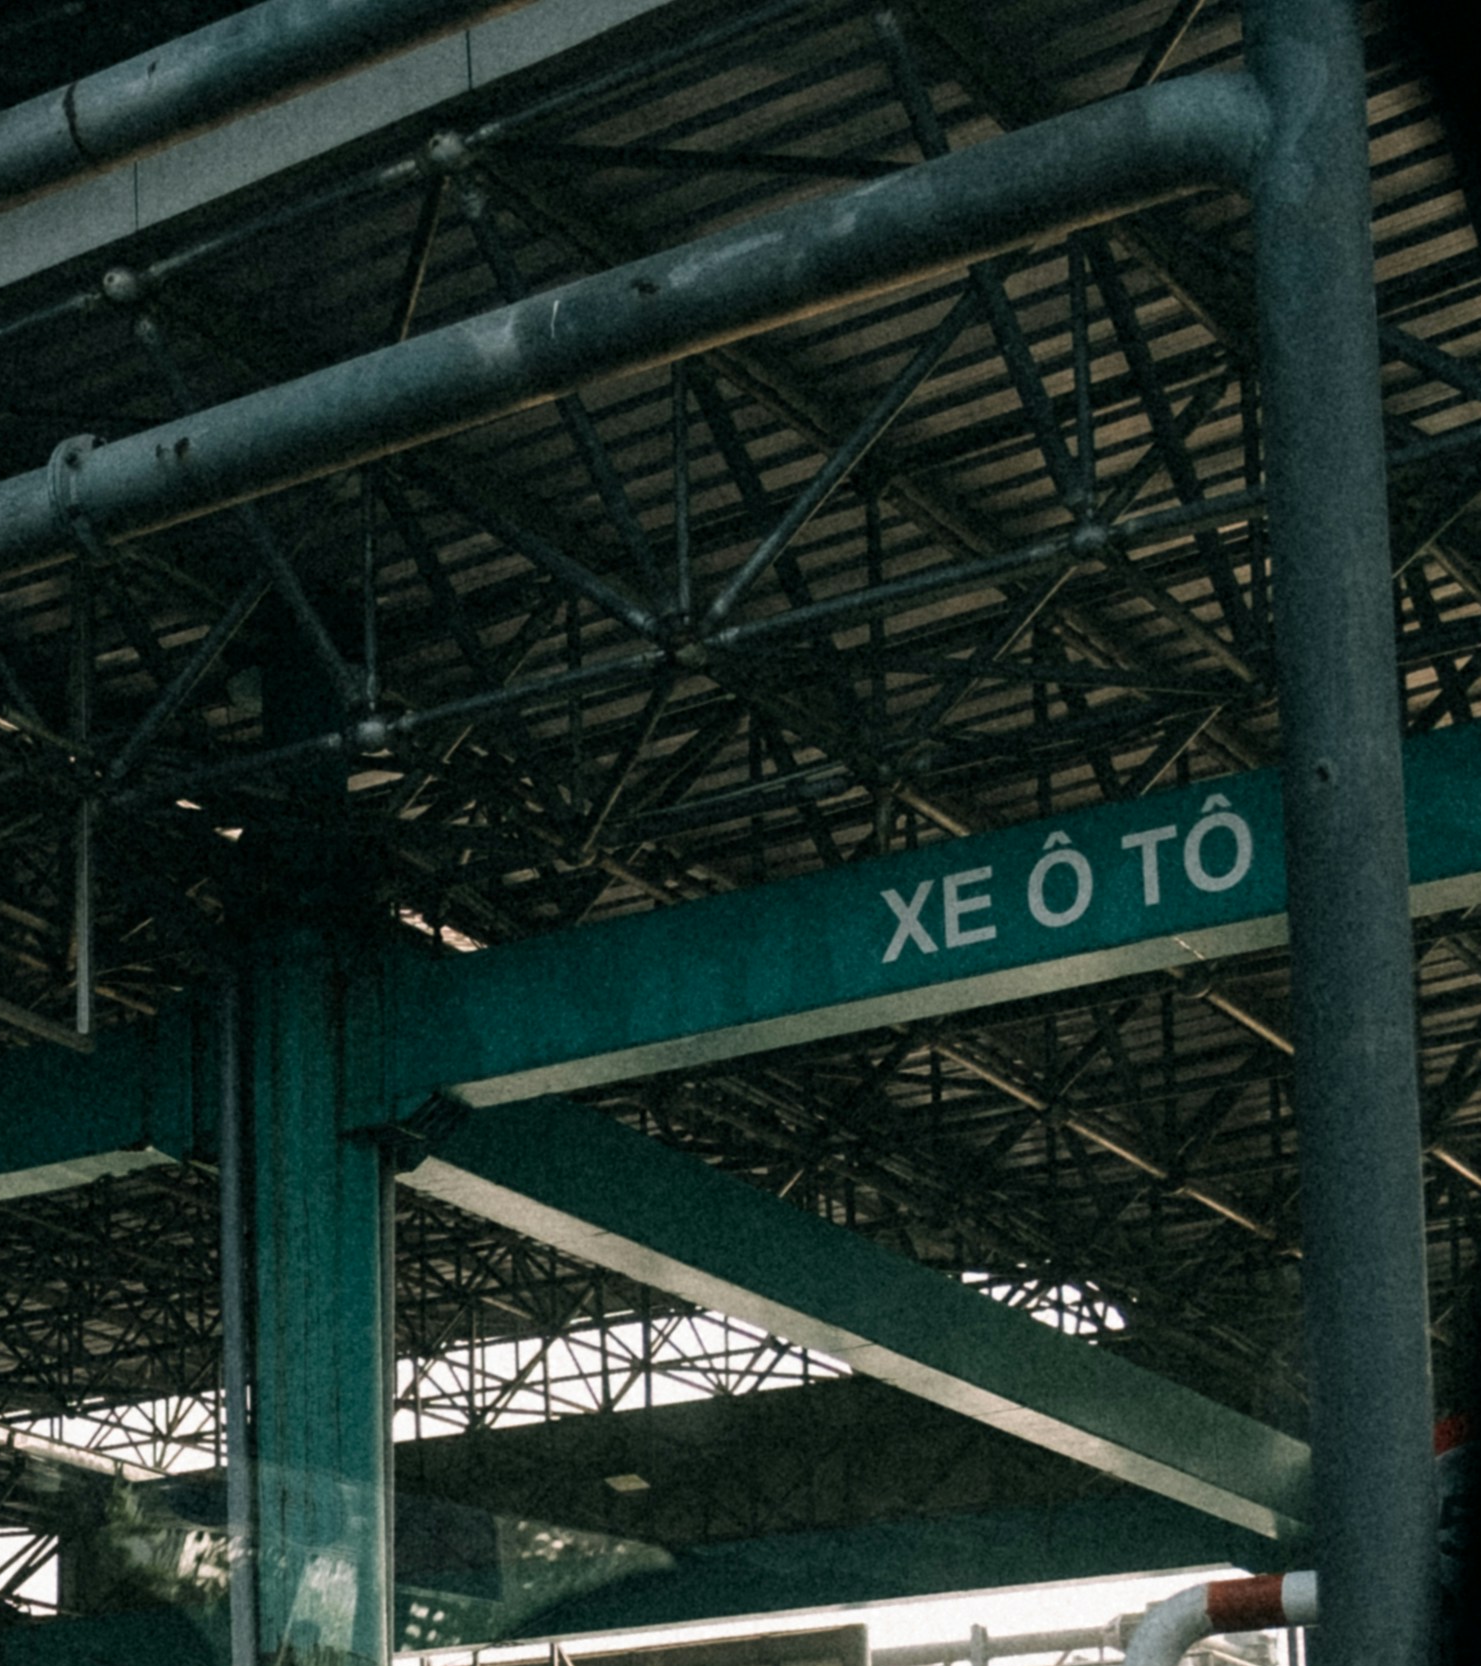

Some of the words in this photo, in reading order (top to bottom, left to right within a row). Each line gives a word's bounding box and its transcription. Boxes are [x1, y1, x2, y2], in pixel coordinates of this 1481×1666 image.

[880, 866, 997, 964] XE
[1027, 830, 1093, 928] Ô
[1121, 793, 1253, 906] TÔ
